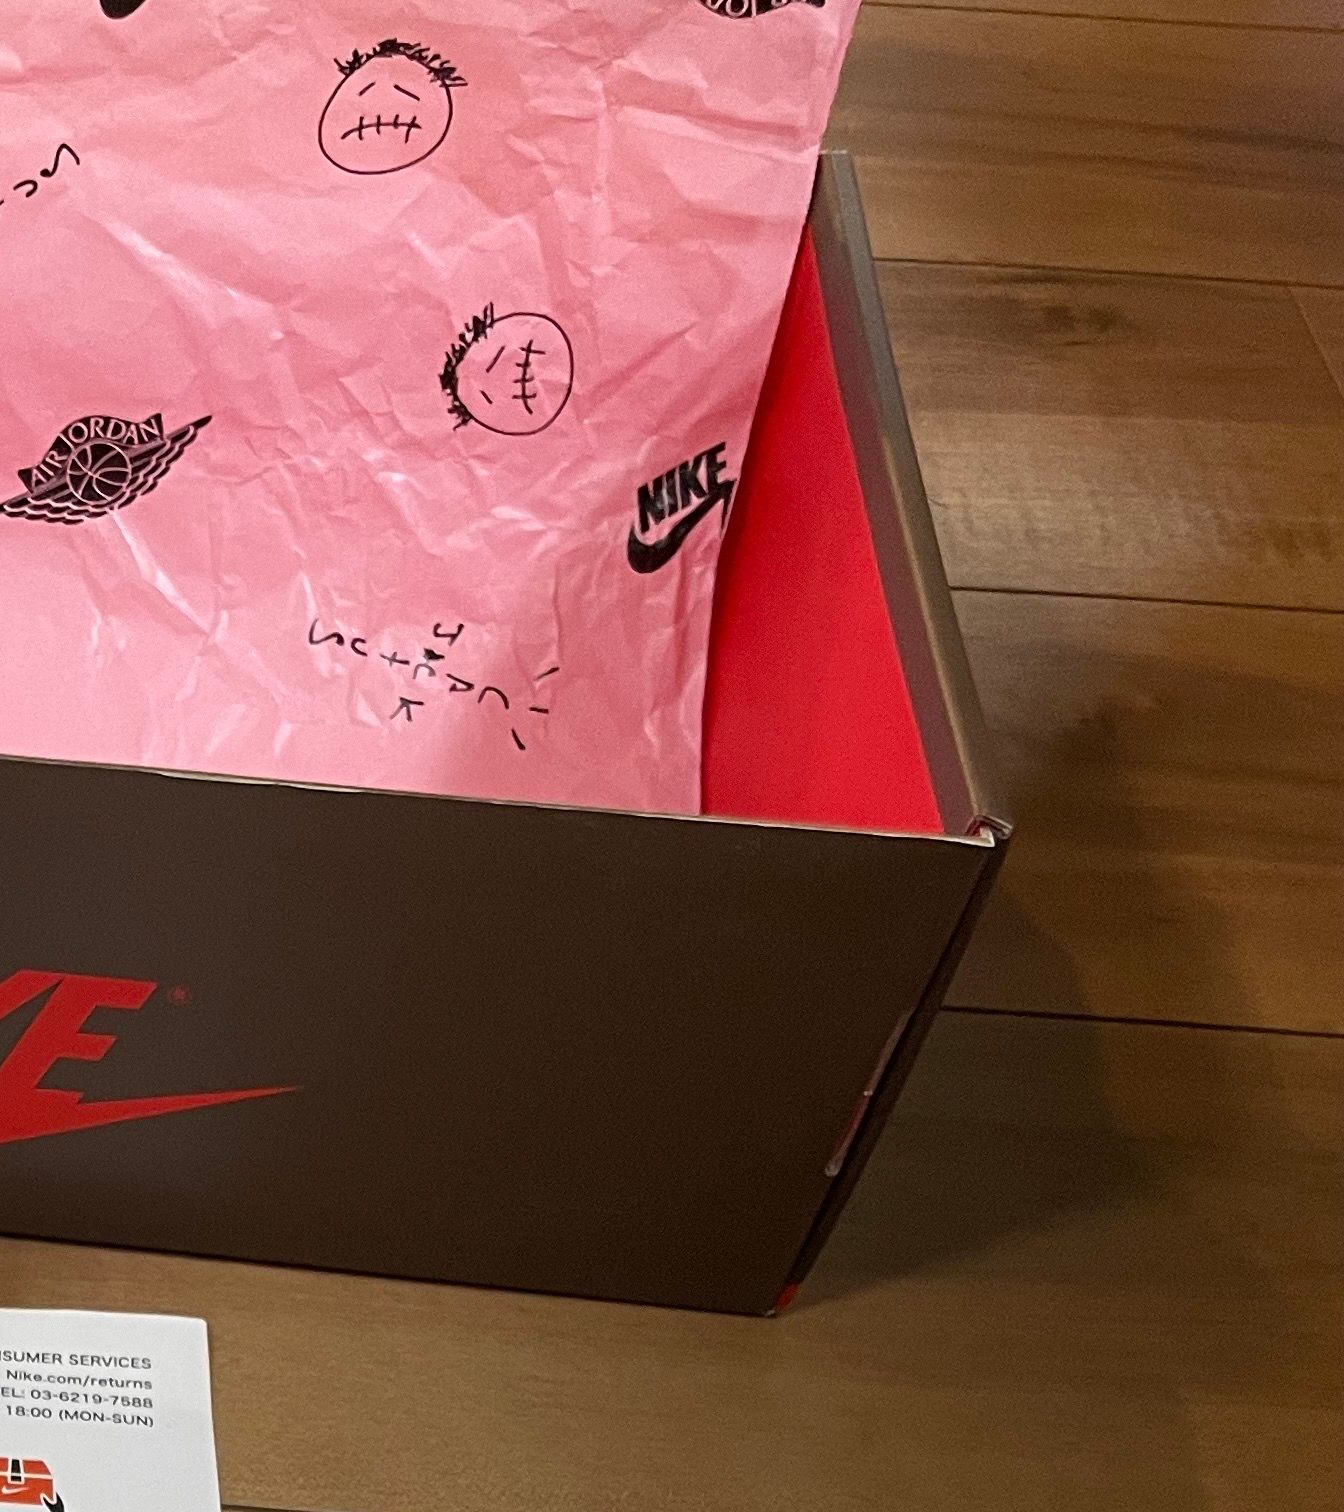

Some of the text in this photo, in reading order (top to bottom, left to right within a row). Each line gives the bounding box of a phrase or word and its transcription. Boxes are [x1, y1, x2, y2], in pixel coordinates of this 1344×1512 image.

[30, 416, 160, 489] AIR JORDAN
[637, 441, 727, 534] NIKE
[69, 1354, 151, 1369] SERVICES
[7, 1370, 152, 1389] Nike.com/returns
[31, 1390, 153, 1408] 03-6219-7588
[7, 1405, 52, 1418] 18:00
[59, 1410, 153, 1427] (MON-SUN)
